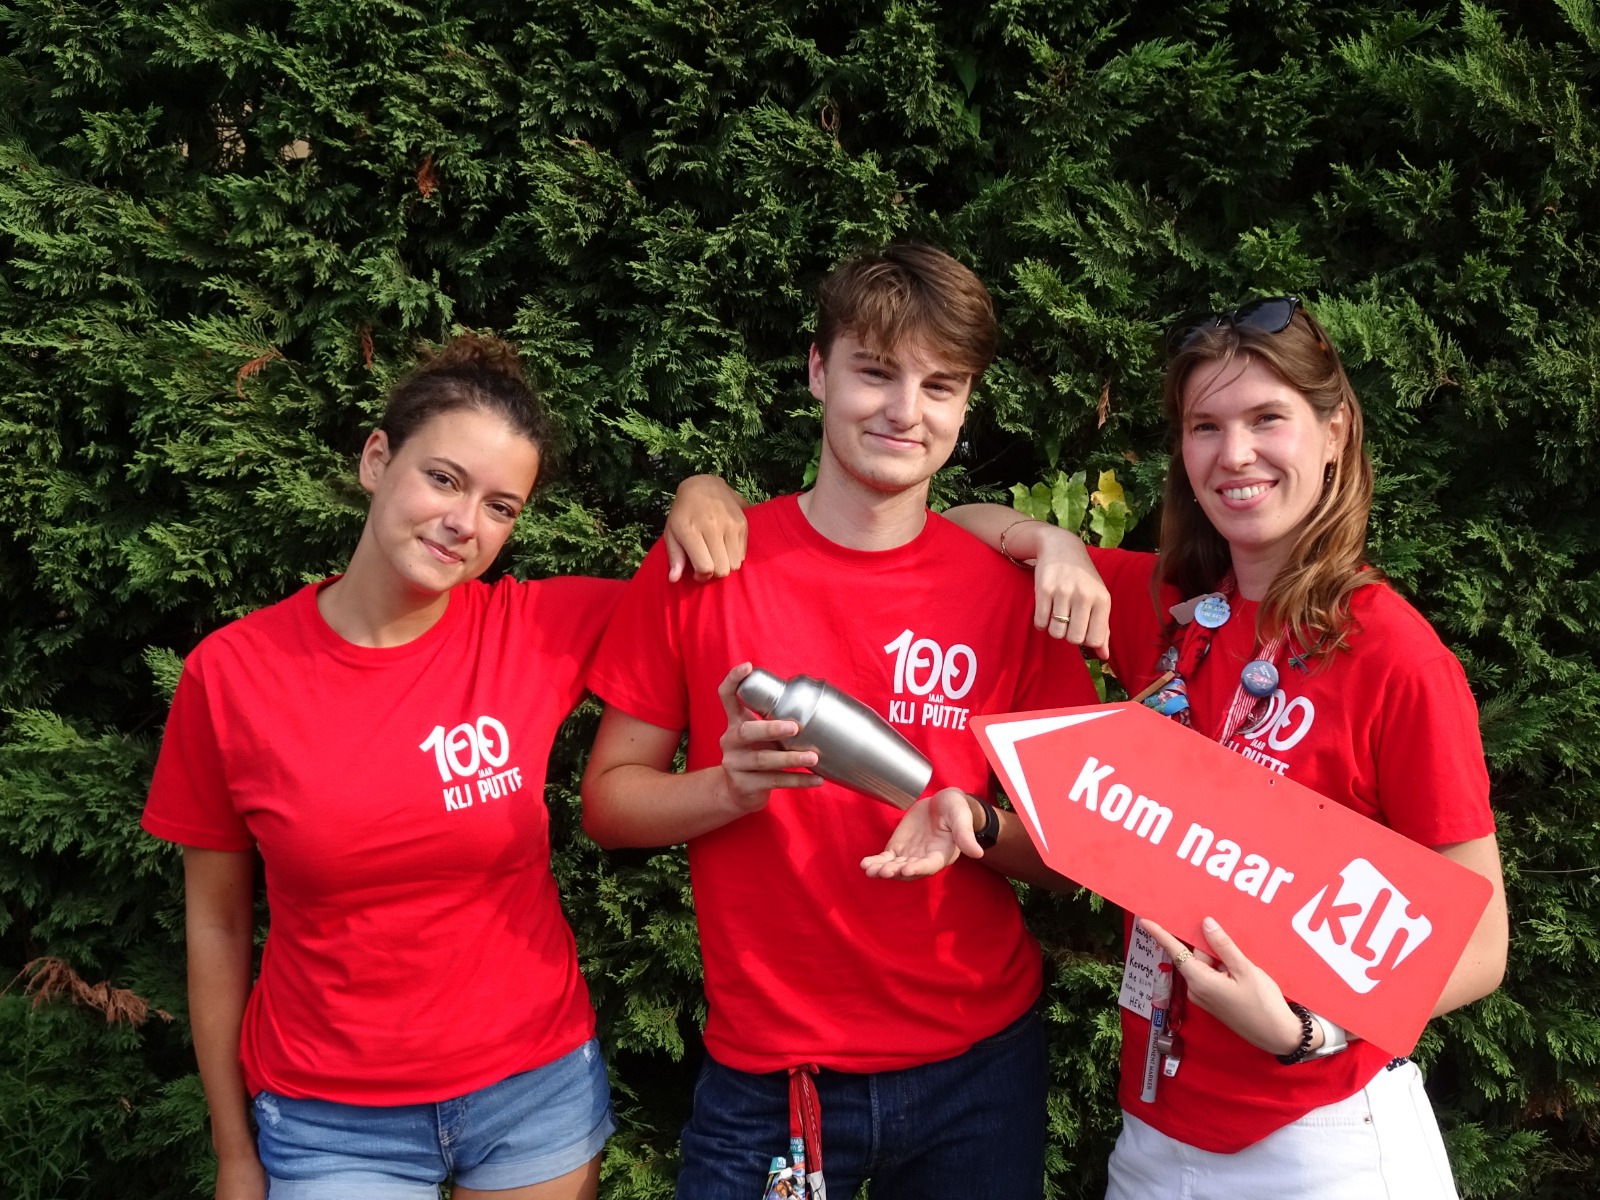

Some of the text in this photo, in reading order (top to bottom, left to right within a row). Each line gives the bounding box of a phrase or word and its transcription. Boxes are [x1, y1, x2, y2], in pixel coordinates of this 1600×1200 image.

[883, 628, 977, 700] 100
[888, 700, 970, 730] KLJ PUTTE
[928, 693, 944, 704] JAAR
[1245, 688, 1315, 751] 00
[418, 715, 510, 783] 100
[1250, 739, 1266, 751] JAAR
[442, 766, 522, 812] KLJ PUTTE
[1068, 756, 1173, 845] Kom
[1176, 822, 1294, 904] naar
[1146, 1029, 1159, 1090] PERMANENT MARKER
